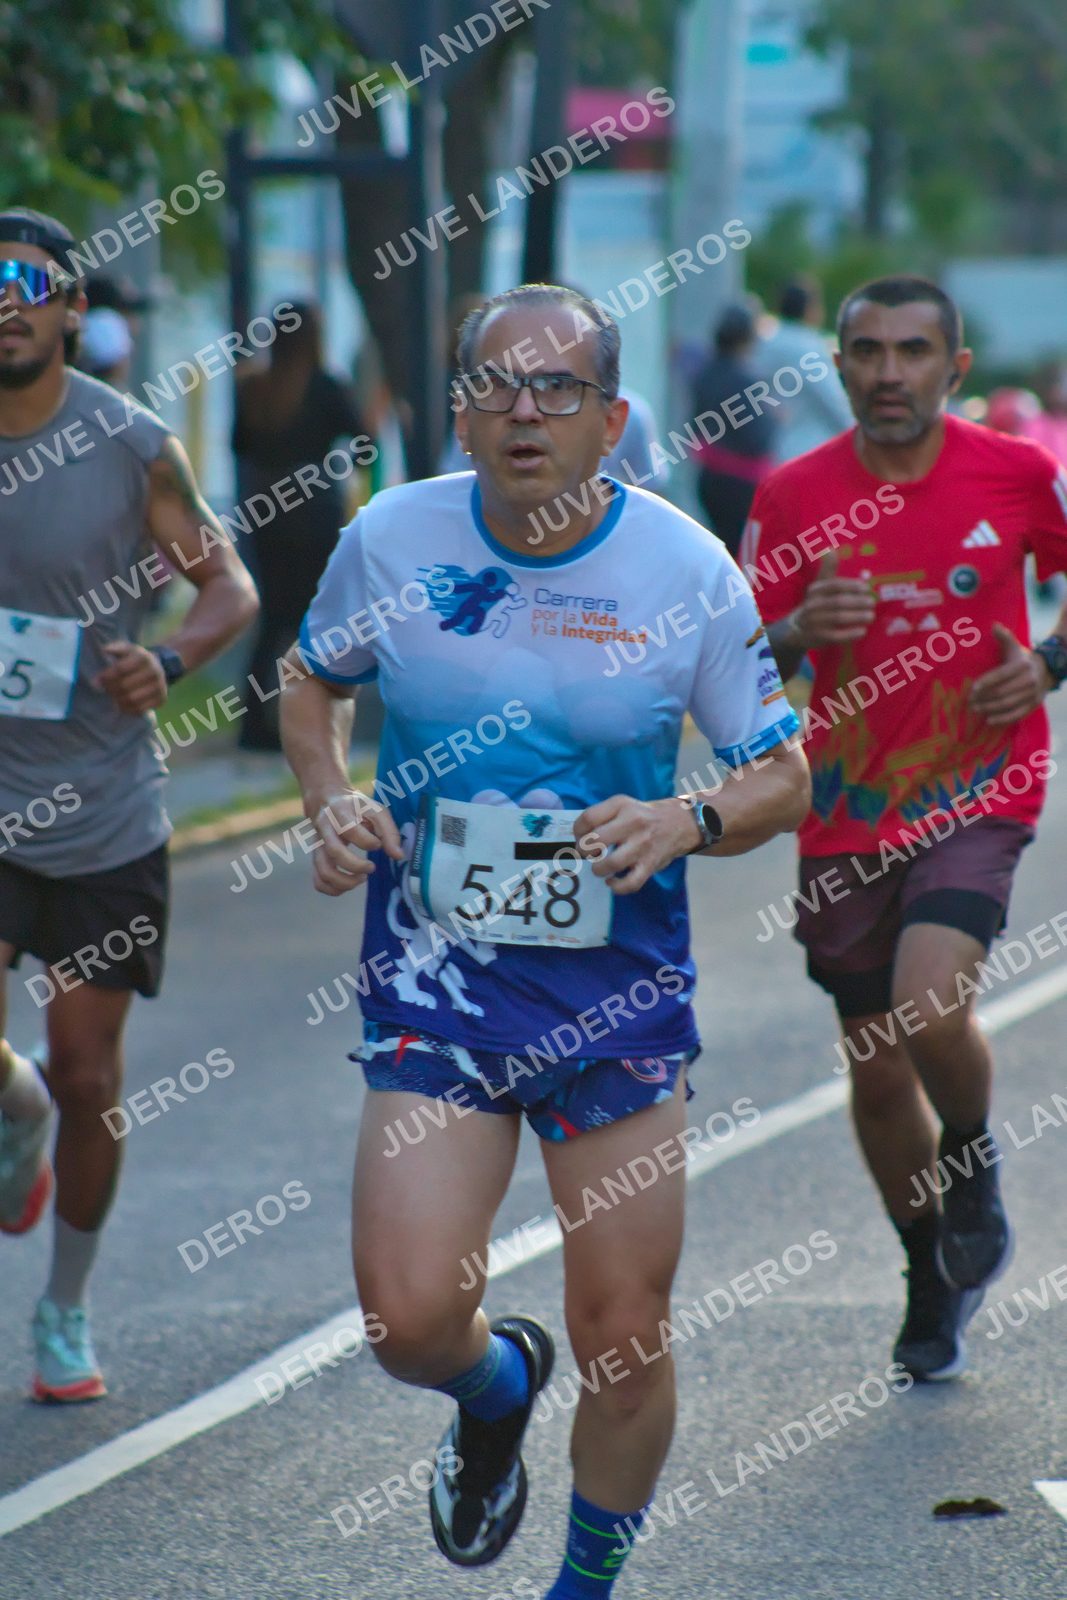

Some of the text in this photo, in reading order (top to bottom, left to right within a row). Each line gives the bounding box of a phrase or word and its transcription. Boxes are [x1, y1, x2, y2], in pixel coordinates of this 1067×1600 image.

[534, 588, 618, 612] Carrera
[532, 608, 618, 627] por la Vida
[531, 622, 647, 644] y la Integridad
[455, 864, 580, 928] 548
